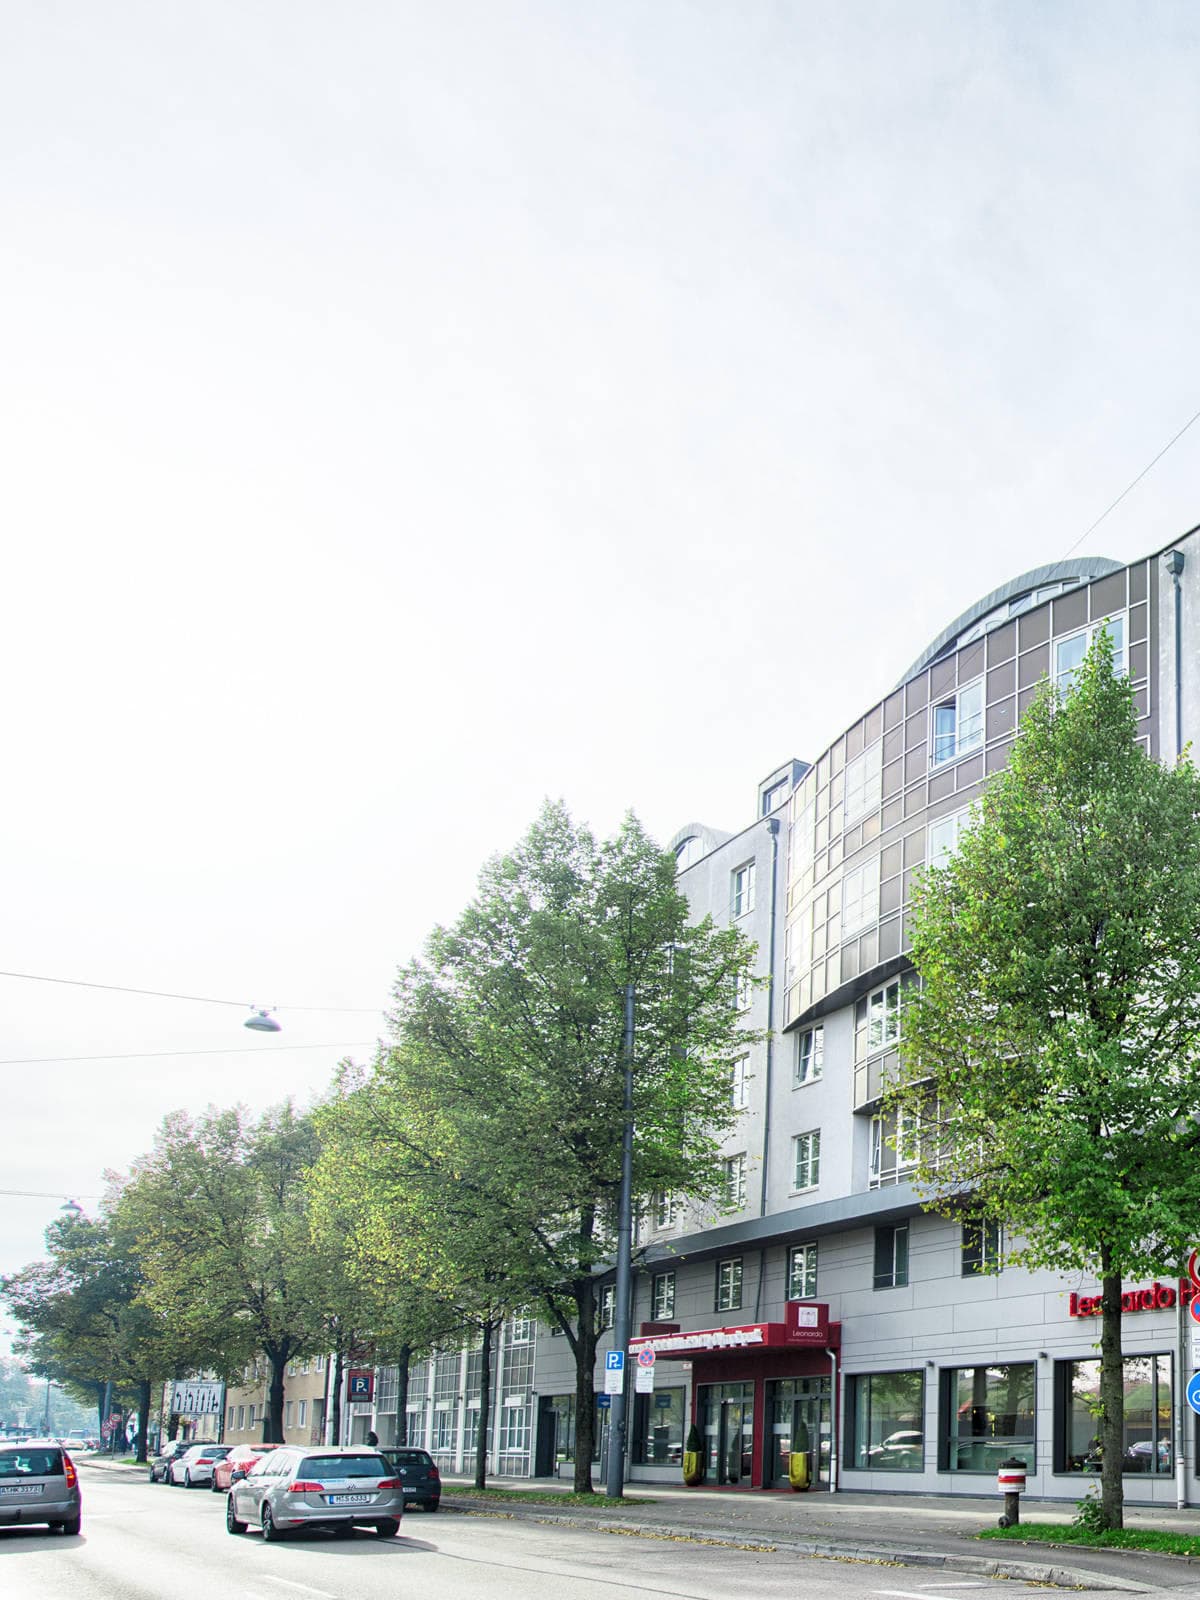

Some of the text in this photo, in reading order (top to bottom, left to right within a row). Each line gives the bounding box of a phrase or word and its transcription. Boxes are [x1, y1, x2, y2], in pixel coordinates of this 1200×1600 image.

[1069, 1281, 1177, 1317] Leoardo
[792, 1329, 823, 1337] Leonardo
[608, 1353, 619, 1368] P
